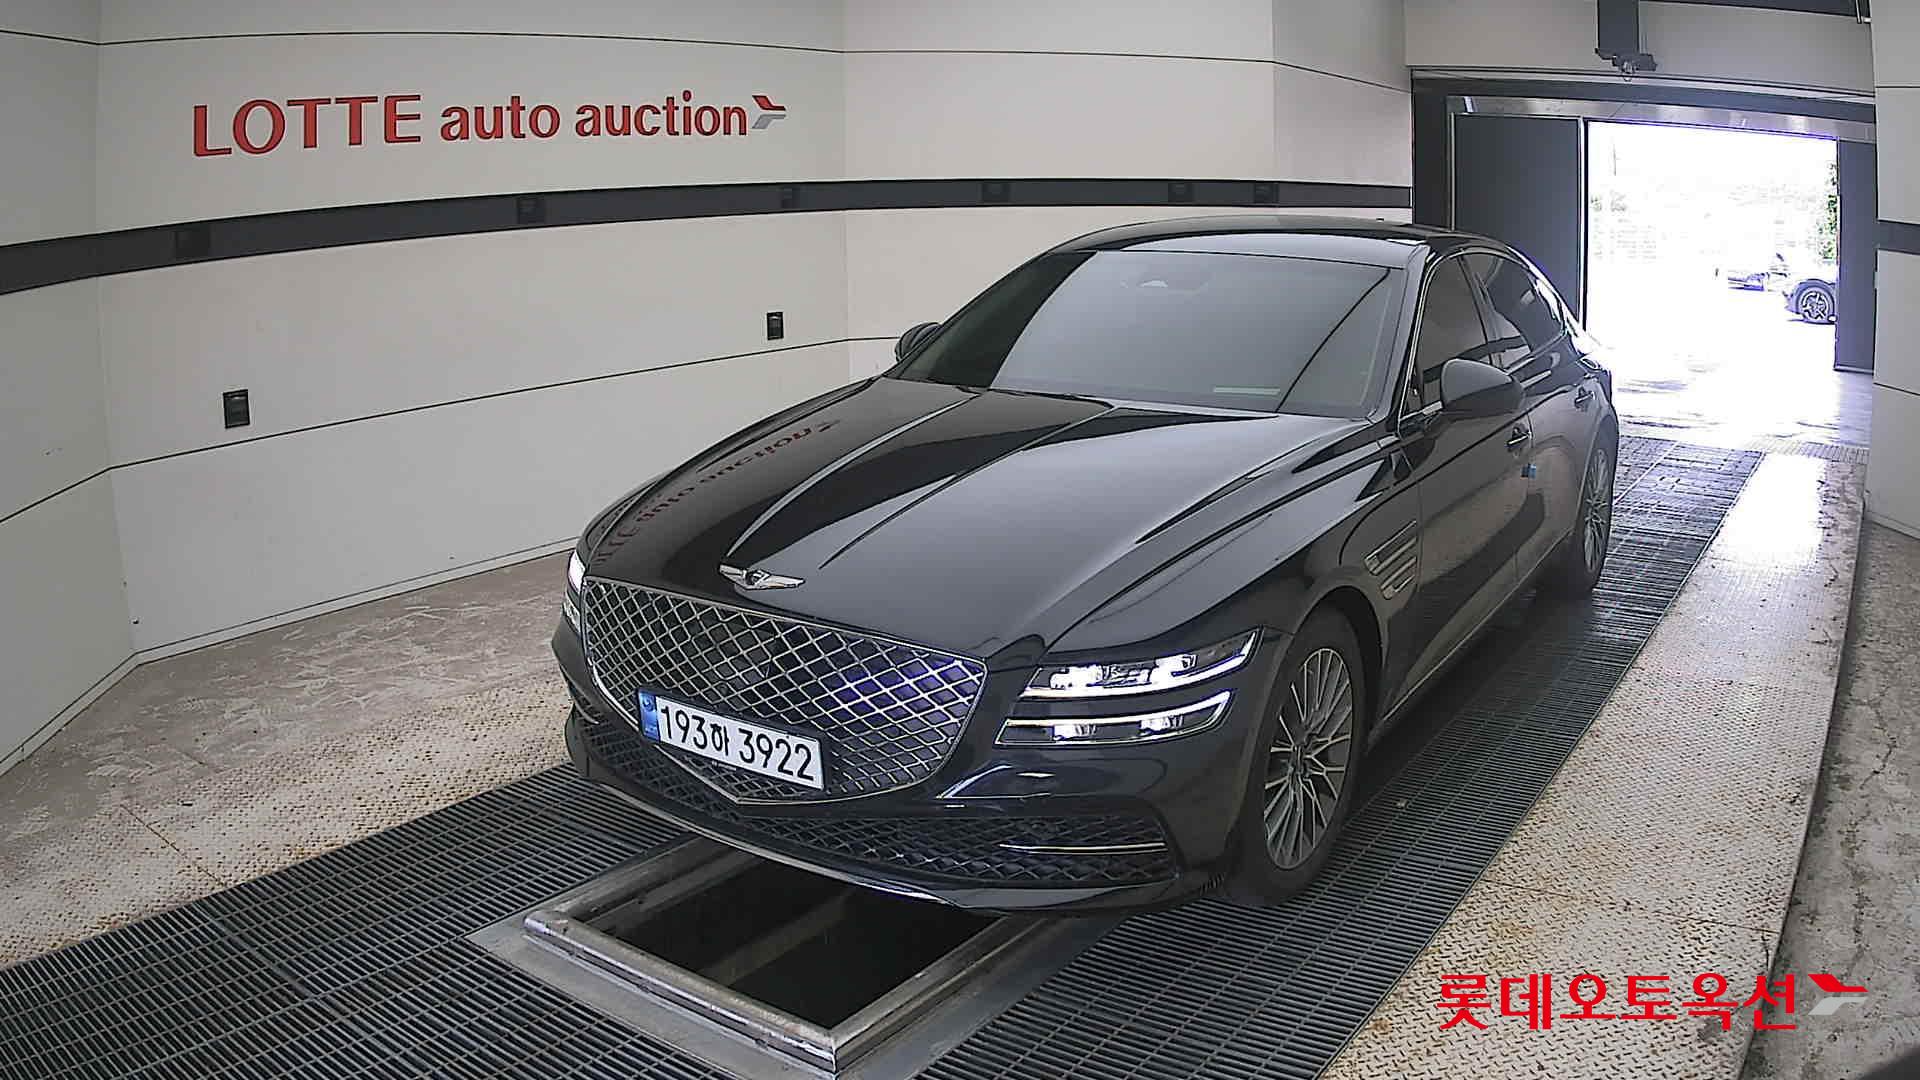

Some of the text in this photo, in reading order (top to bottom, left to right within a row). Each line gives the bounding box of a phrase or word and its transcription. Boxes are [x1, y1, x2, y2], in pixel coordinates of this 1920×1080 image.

[193, 90, 748, 157] LOTTE auto auction
[661, 705, 814, 781] 193하 3922
